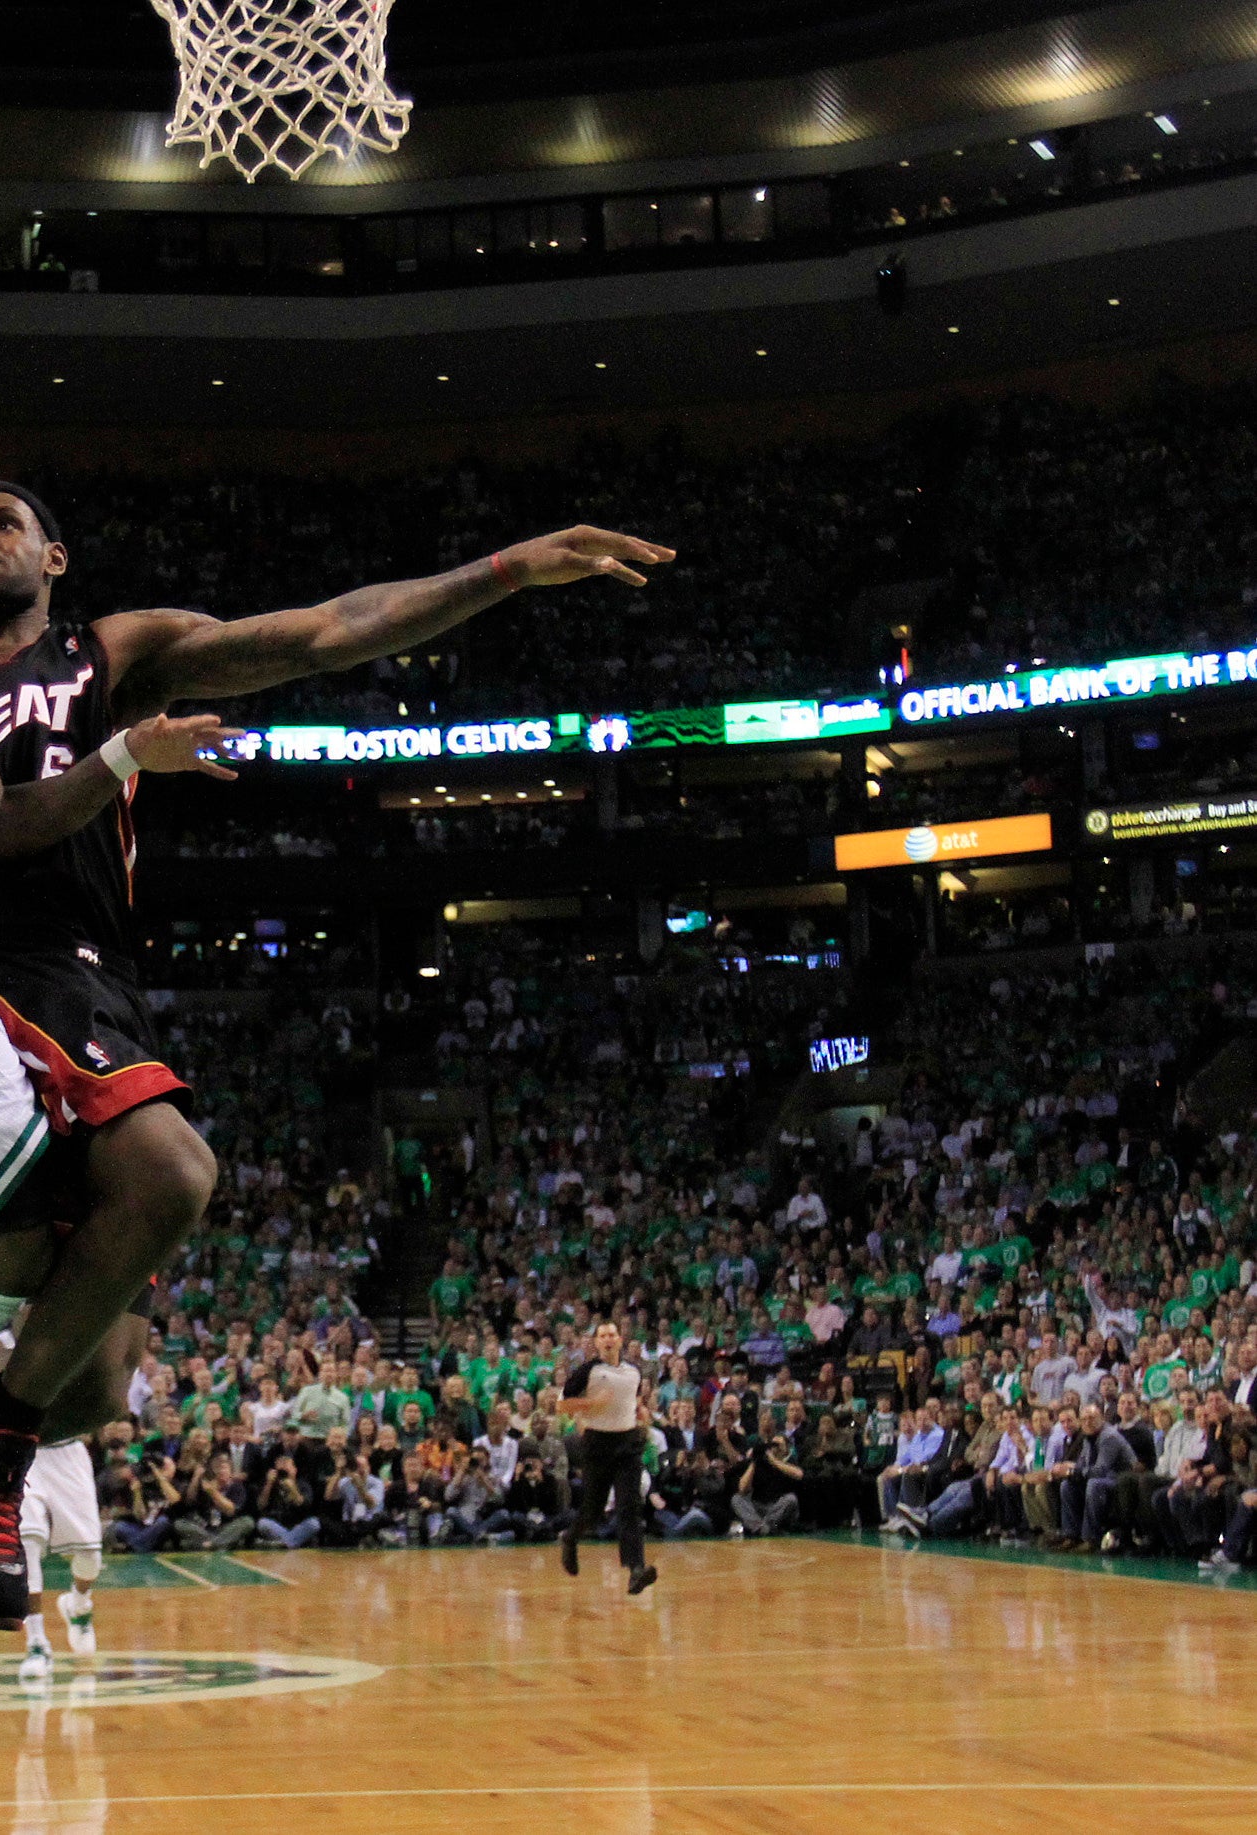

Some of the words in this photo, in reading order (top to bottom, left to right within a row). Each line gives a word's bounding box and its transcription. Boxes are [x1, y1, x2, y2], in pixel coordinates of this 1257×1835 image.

[901, 680, 1024, 721] OFFICIAL
[1029, 668, 1110, 706] BANK
[1117, 663, 1156, 695] OF
[1162, 653, 1220, 689] THE
[265, 731, 322, 760] THE
[327, 727, 441, 760] BOSTON
[447, 721, 552, 754] CELTICS
[1228, 800, 1247, 815] and
[941, 831, 979, 851] at&t
